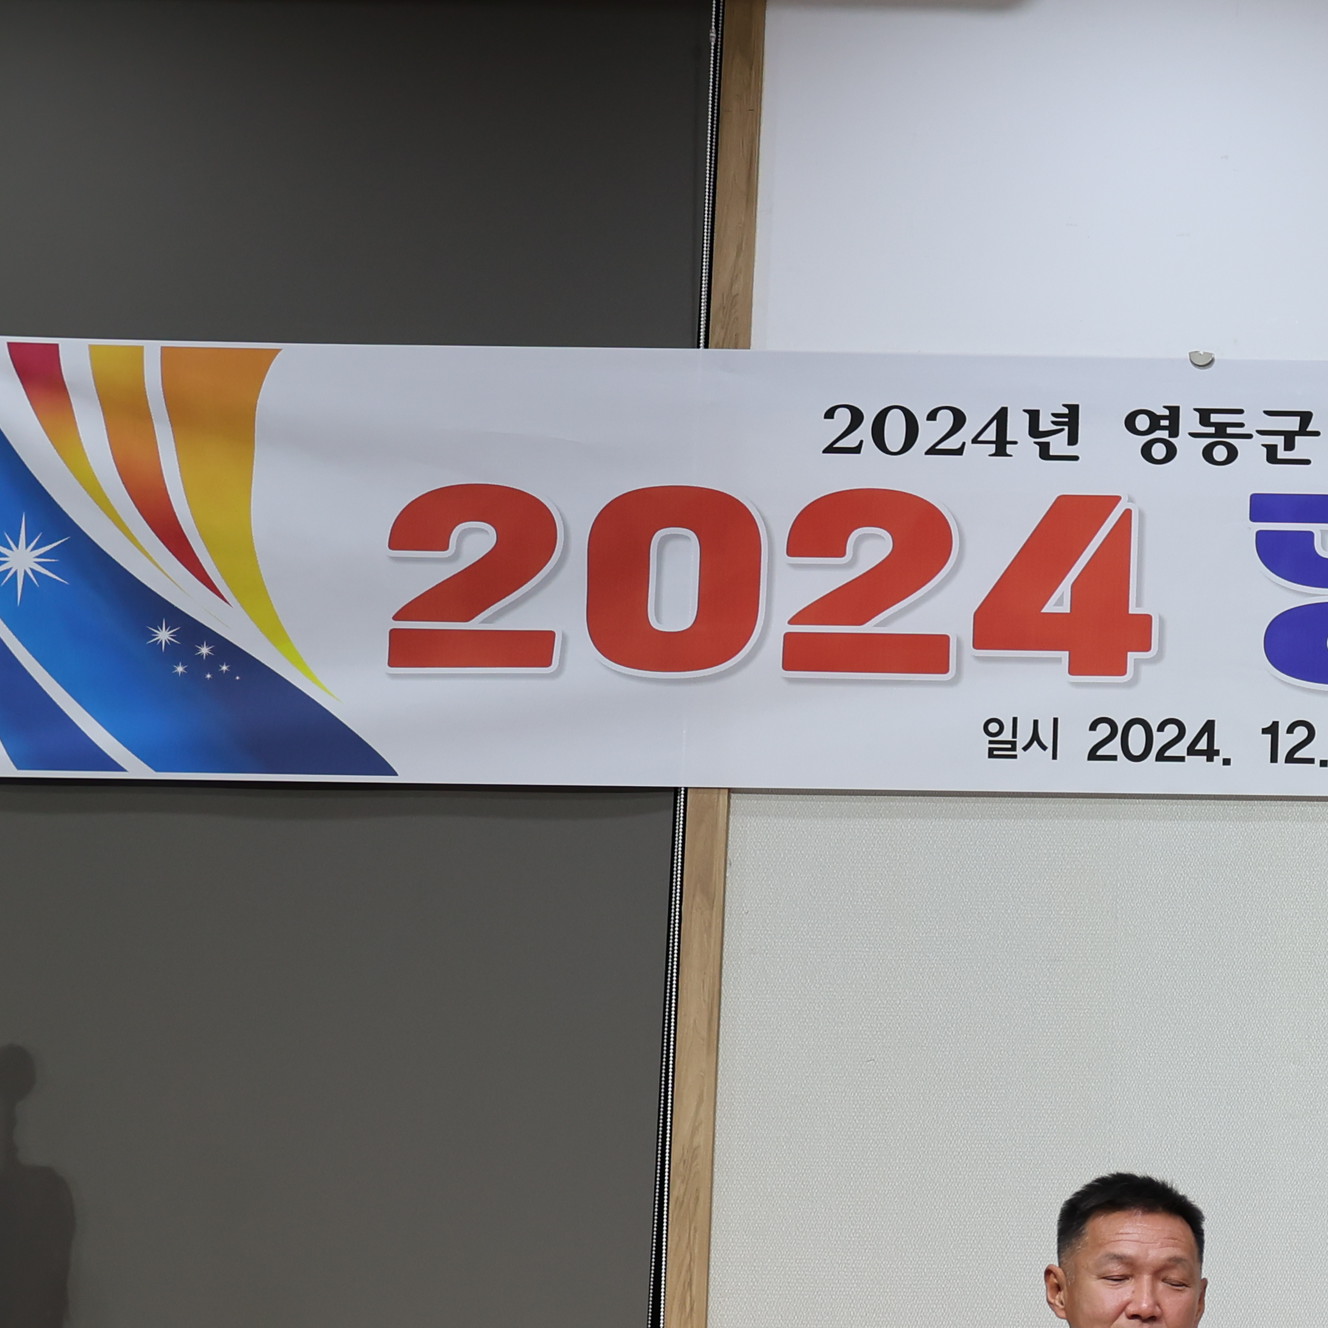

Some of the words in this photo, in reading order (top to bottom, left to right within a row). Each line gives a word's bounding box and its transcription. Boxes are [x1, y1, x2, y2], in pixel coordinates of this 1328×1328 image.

[822, 404, 1079, 461] 2024년
[1125, 406, 1320, 466] 영동군
[389, 484, 1153, 677] 2024
[983, 717, 1059, 760] 일시
[1087, 717, 1231, 766] 2024.
[1262, 720, 1328, 768] 12.
